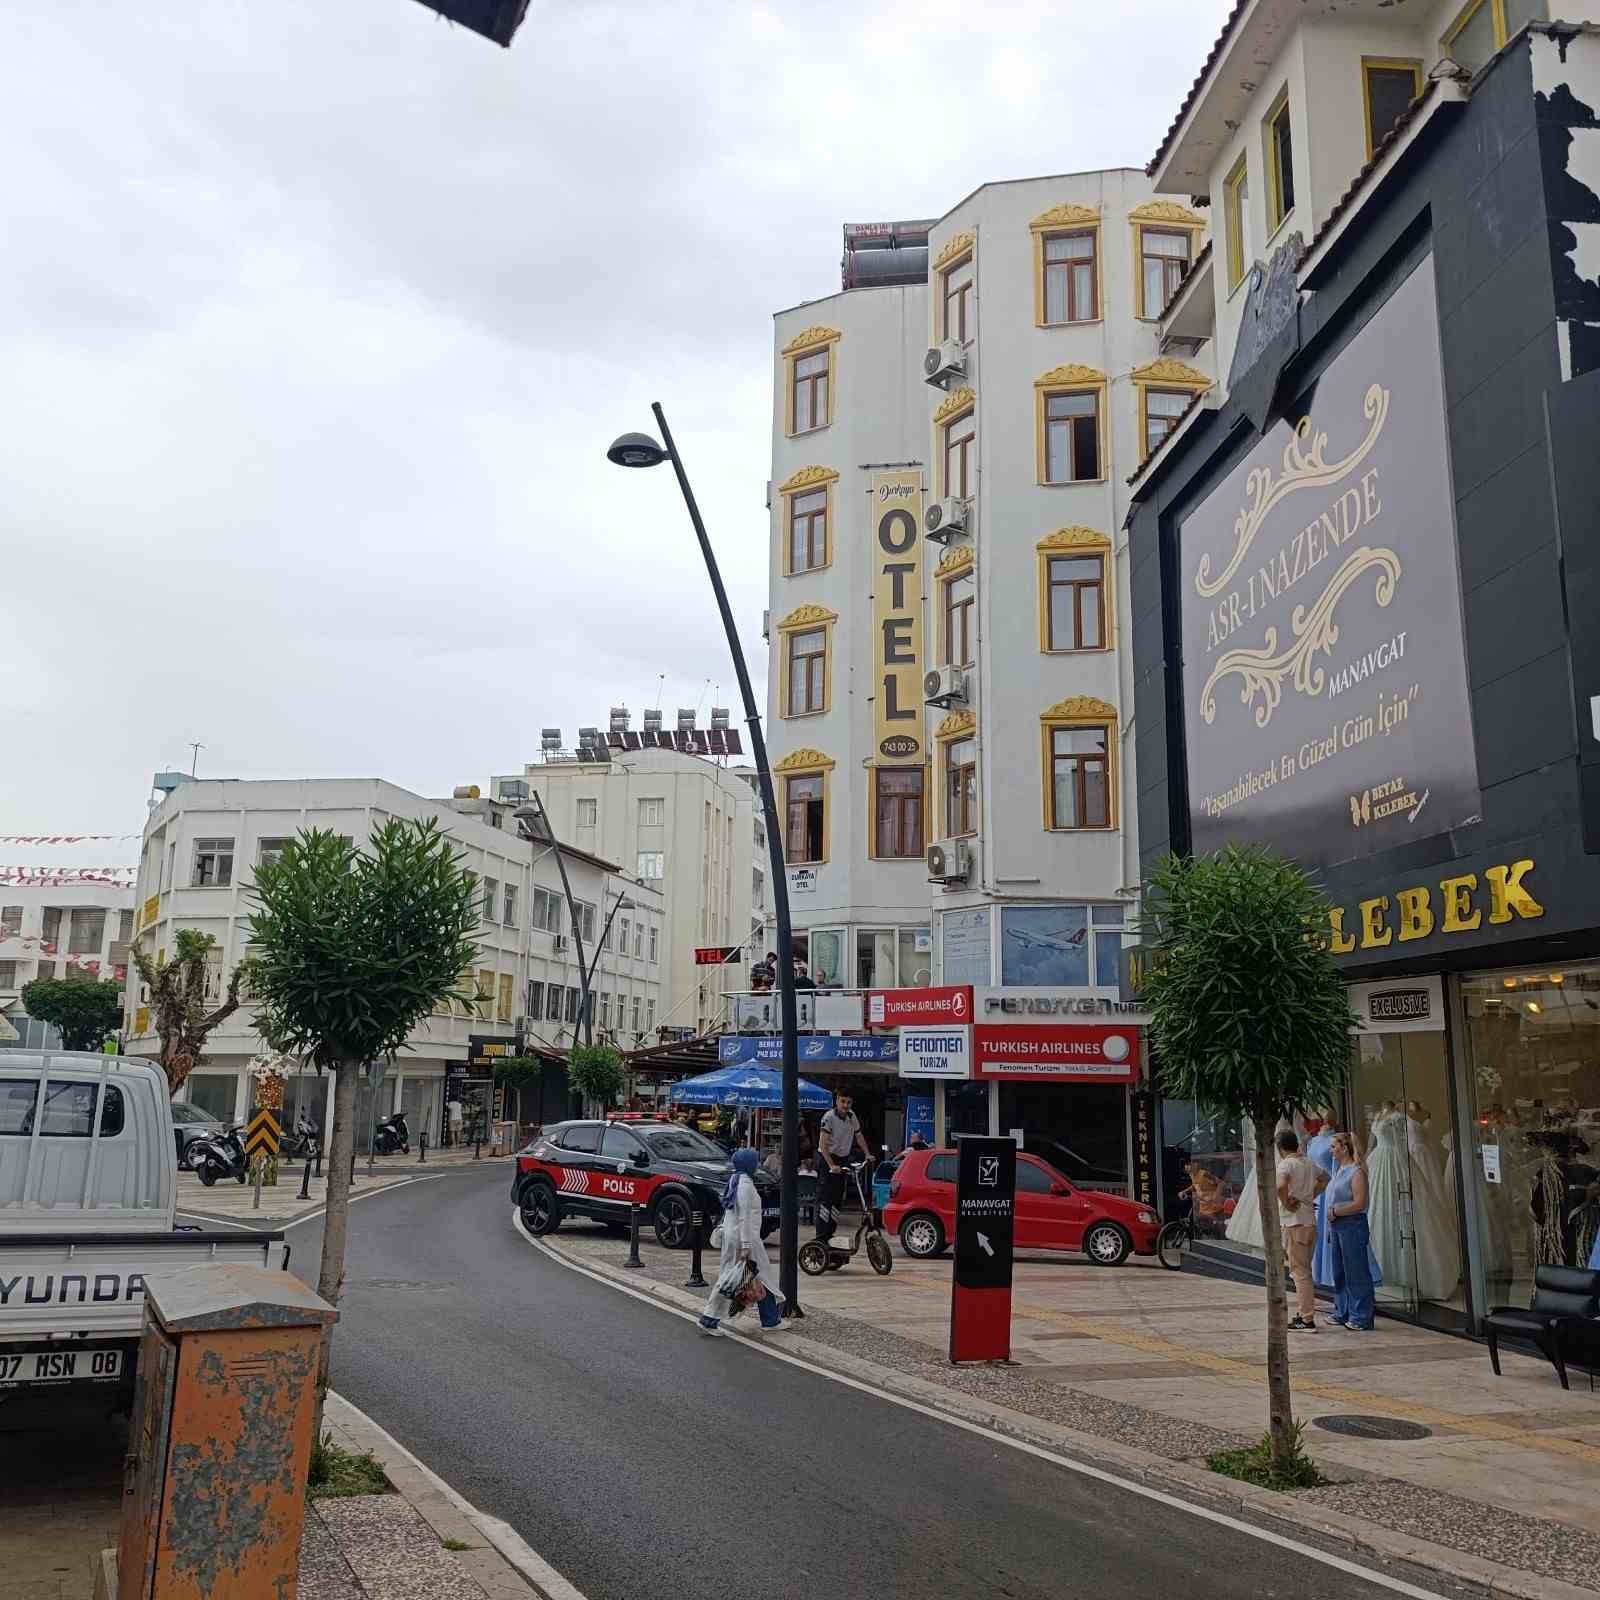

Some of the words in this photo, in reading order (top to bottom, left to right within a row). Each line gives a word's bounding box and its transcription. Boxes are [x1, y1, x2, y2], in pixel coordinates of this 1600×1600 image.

[1259, 467, 1383, 609] NAZENDE
[878, 508, 918, 722] OTEL
[1327, 631, 1407, 700] MANAVGAT
[884, 742, 897, 752] 743
[1281, 755, 1295, 780] En
[1299, 726, 1338, 771] Güzel
[1342, 715, 1374, 750] Gün
[1371, 776, 1404, 801] BEYAZ
[1373, 791, 1419, 821] KELEBEK
[1302, 858, 1545, 954] LEBEK
[887, 1001, 917, 1014] TURKISH
[919, 999, 951, 1012] AIRLINES
[982, 1041, 1038, 1054] TURKISH
[1040, 1042, 1101, 1055] AIRLINES
[1000, 1064, 1033, 1073] Fenomen
[961, 1199, 1011, 1209] MANAVGAT
[0, 1274, 145, 1304] YUNDA
[35, 1353, 76, 1377] MSN
[91, 1351, 117, 1374] 08
